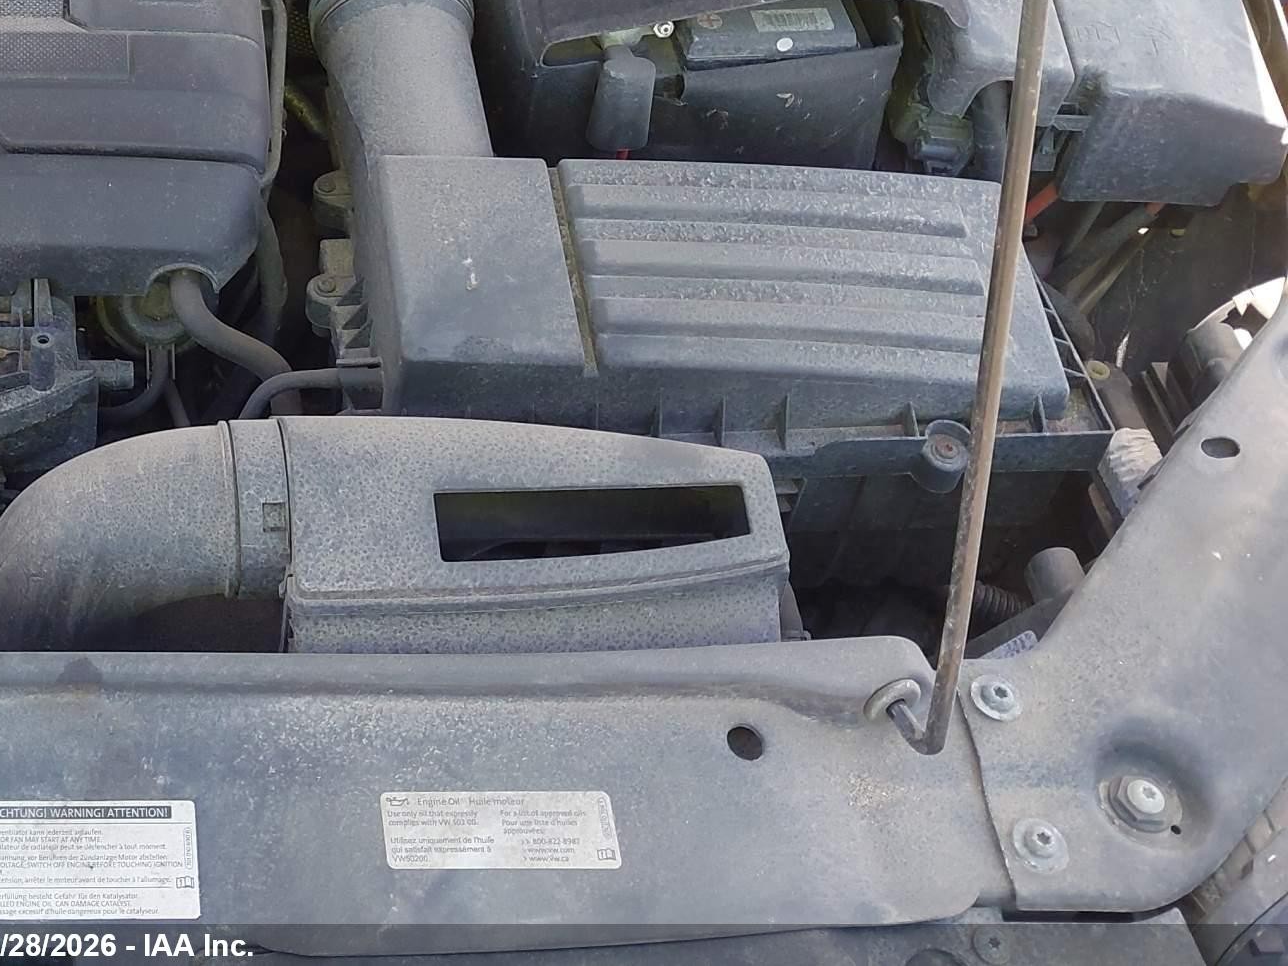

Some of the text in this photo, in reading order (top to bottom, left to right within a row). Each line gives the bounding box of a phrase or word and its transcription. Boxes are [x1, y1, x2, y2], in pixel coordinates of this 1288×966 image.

[417, 798, 460, 807] Engine Oil
[468, 798, 525, 806] Huile moteur
[50, 808, 104, 818] WARNING!
[107, 808, 168, 818] ATTENTION!
